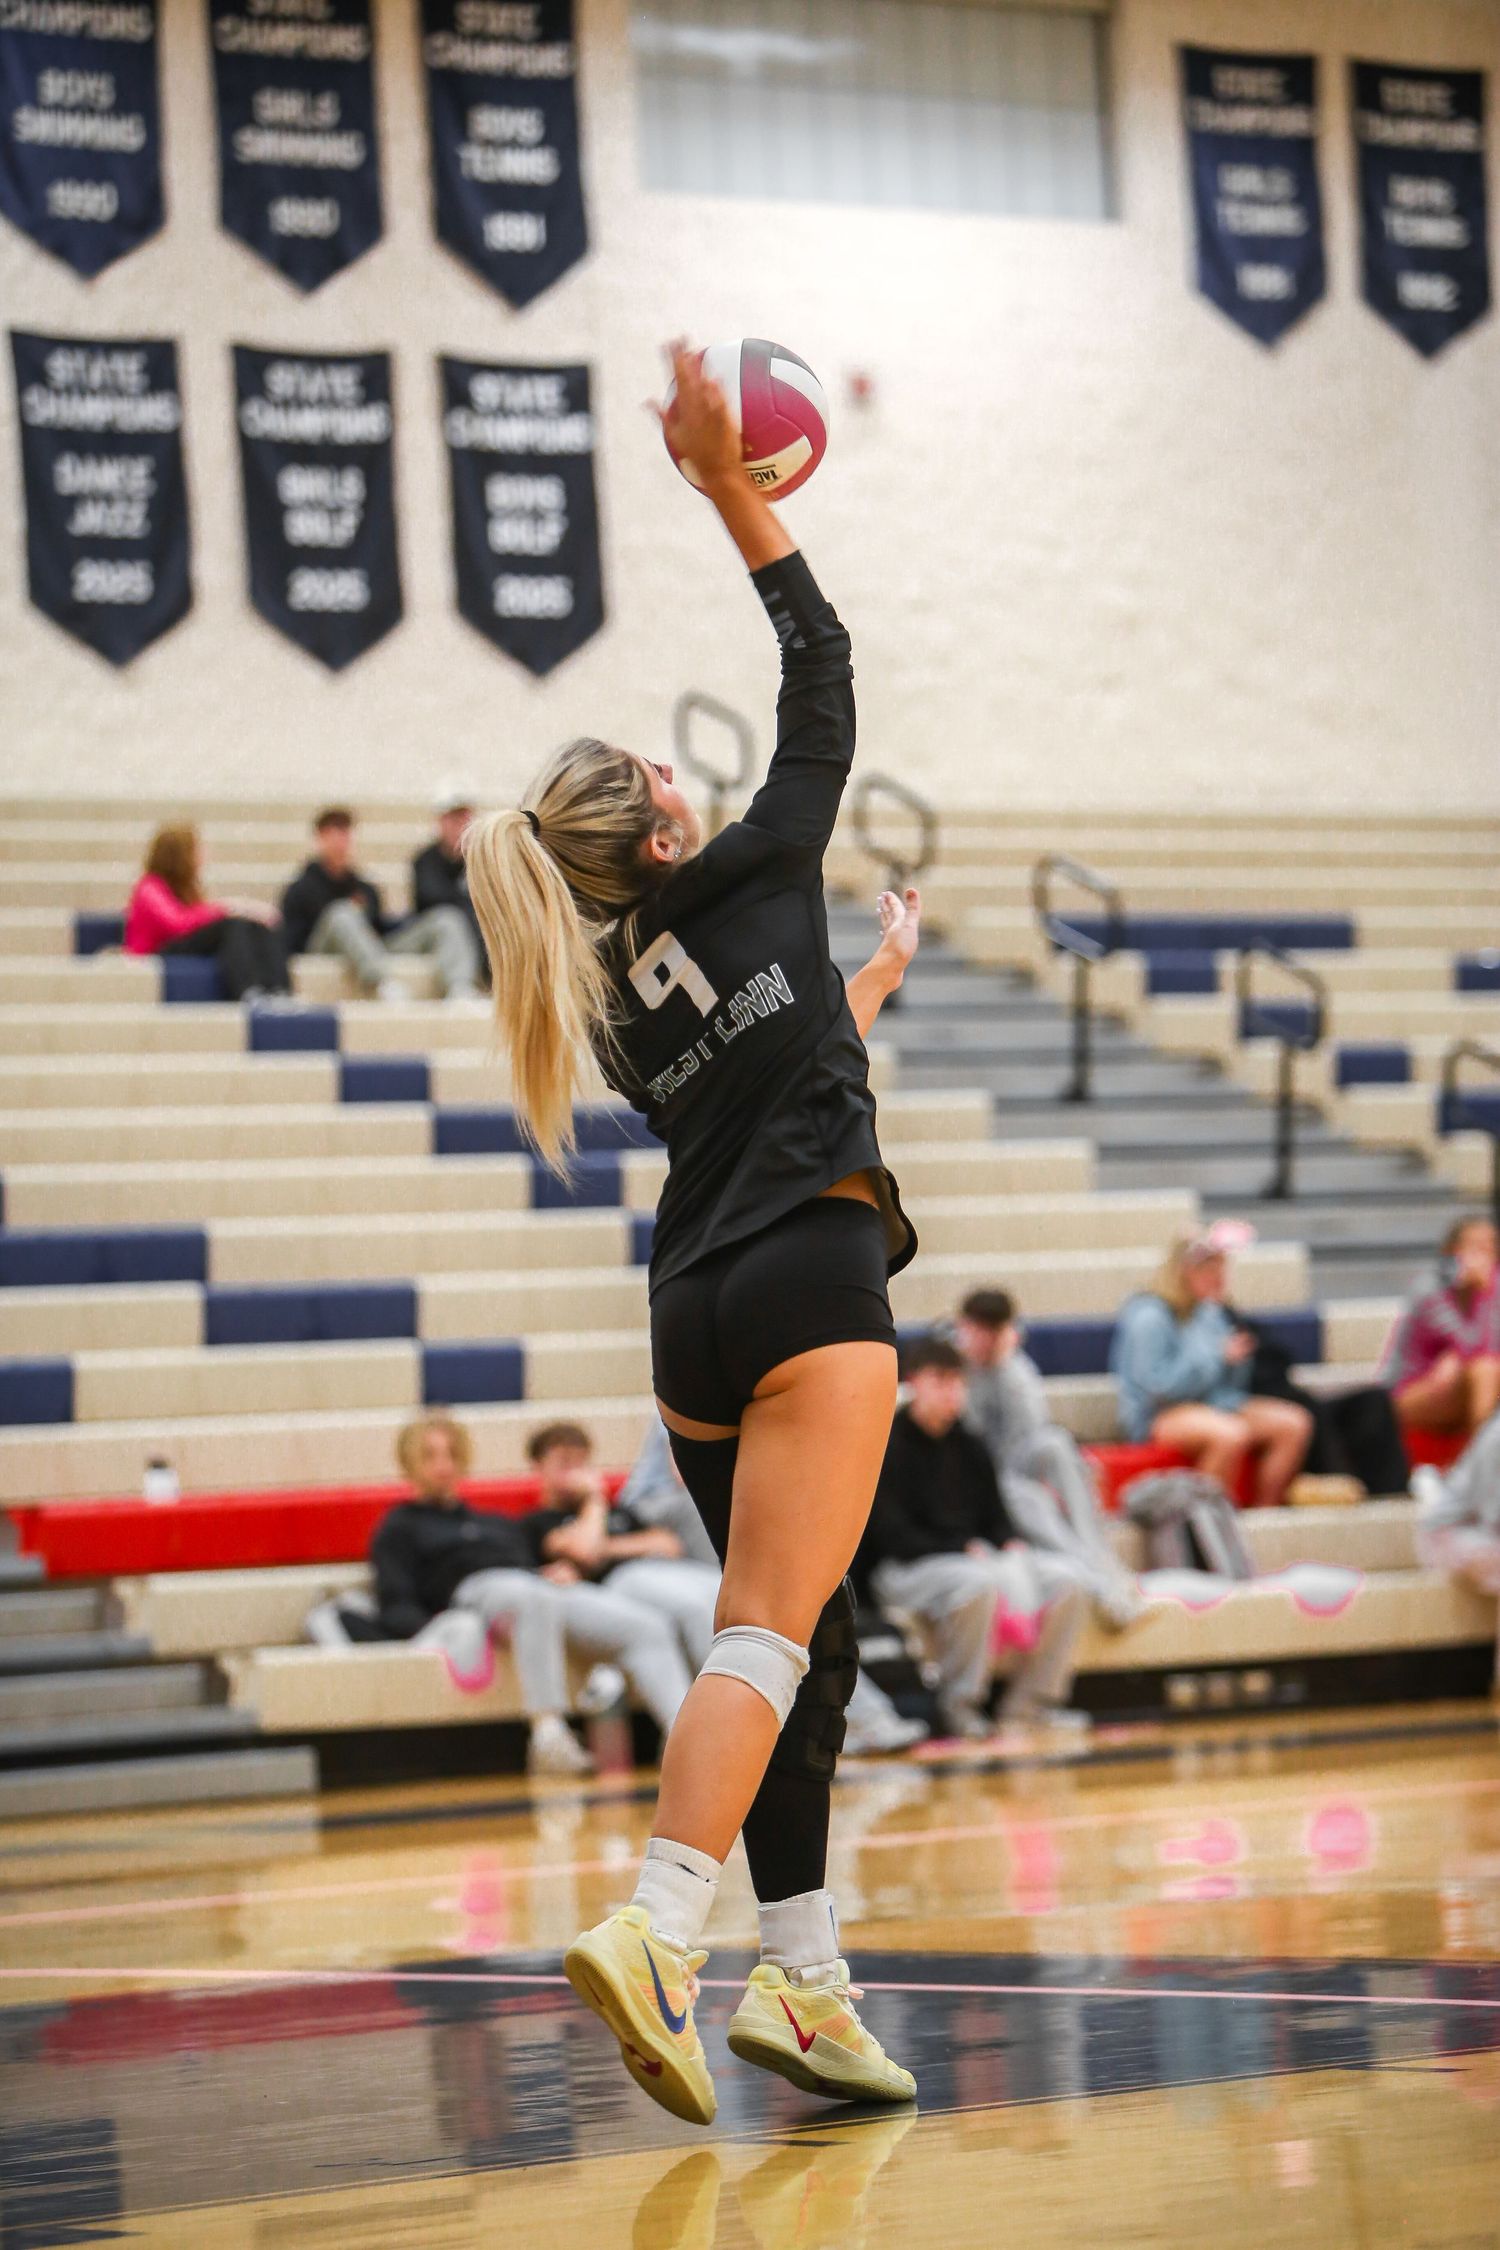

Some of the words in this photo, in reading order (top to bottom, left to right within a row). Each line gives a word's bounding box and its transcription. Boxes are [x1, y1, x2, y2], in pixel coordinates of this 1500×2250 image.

[45, 349, 149, 393] STATE
[264, 361, 364, 403] STATE
[470, 372, 569, 415] STATE
[627, 930, 719, 1018] 9
[714, 962, 795, 1044] LINN
